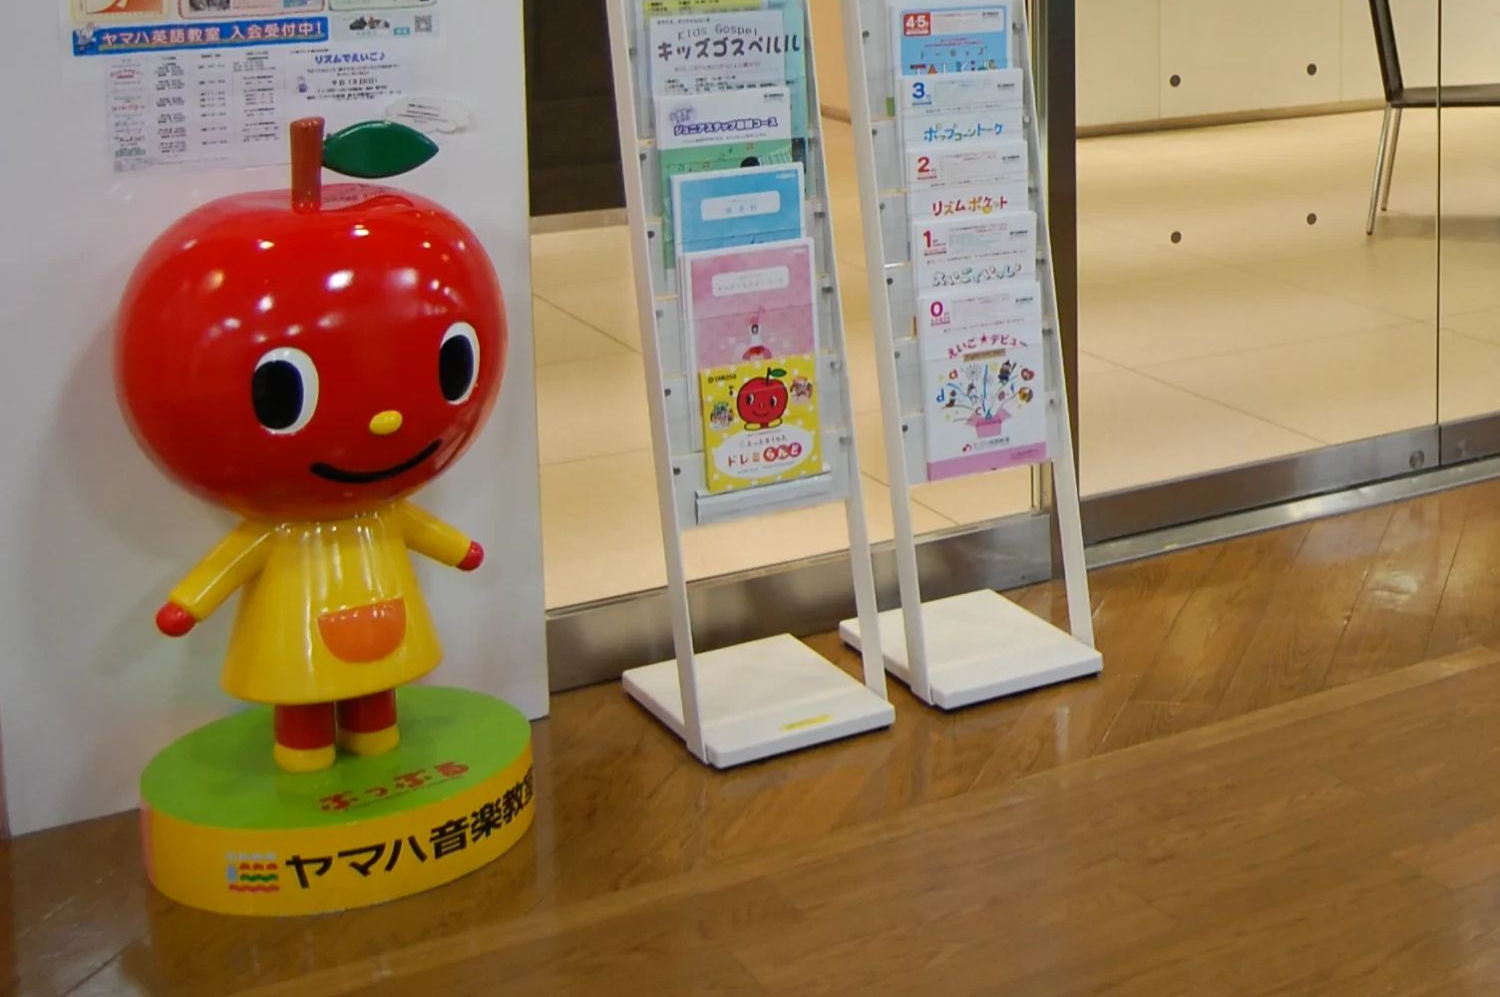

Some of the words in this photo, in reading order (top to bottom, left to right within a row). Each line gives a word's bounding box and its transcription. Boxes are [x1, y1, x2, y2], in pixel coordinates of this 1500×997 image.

[102, 27, 220, 47] ヤマハ英語教室
[678, 25, 707, 40] Kids
[715, 23, 758, 37] Gospel
[657, 36, 782, 61] キッズゴスペル
[912, 82, 925, 99] 3
[917, 157, 930, 173] 2
